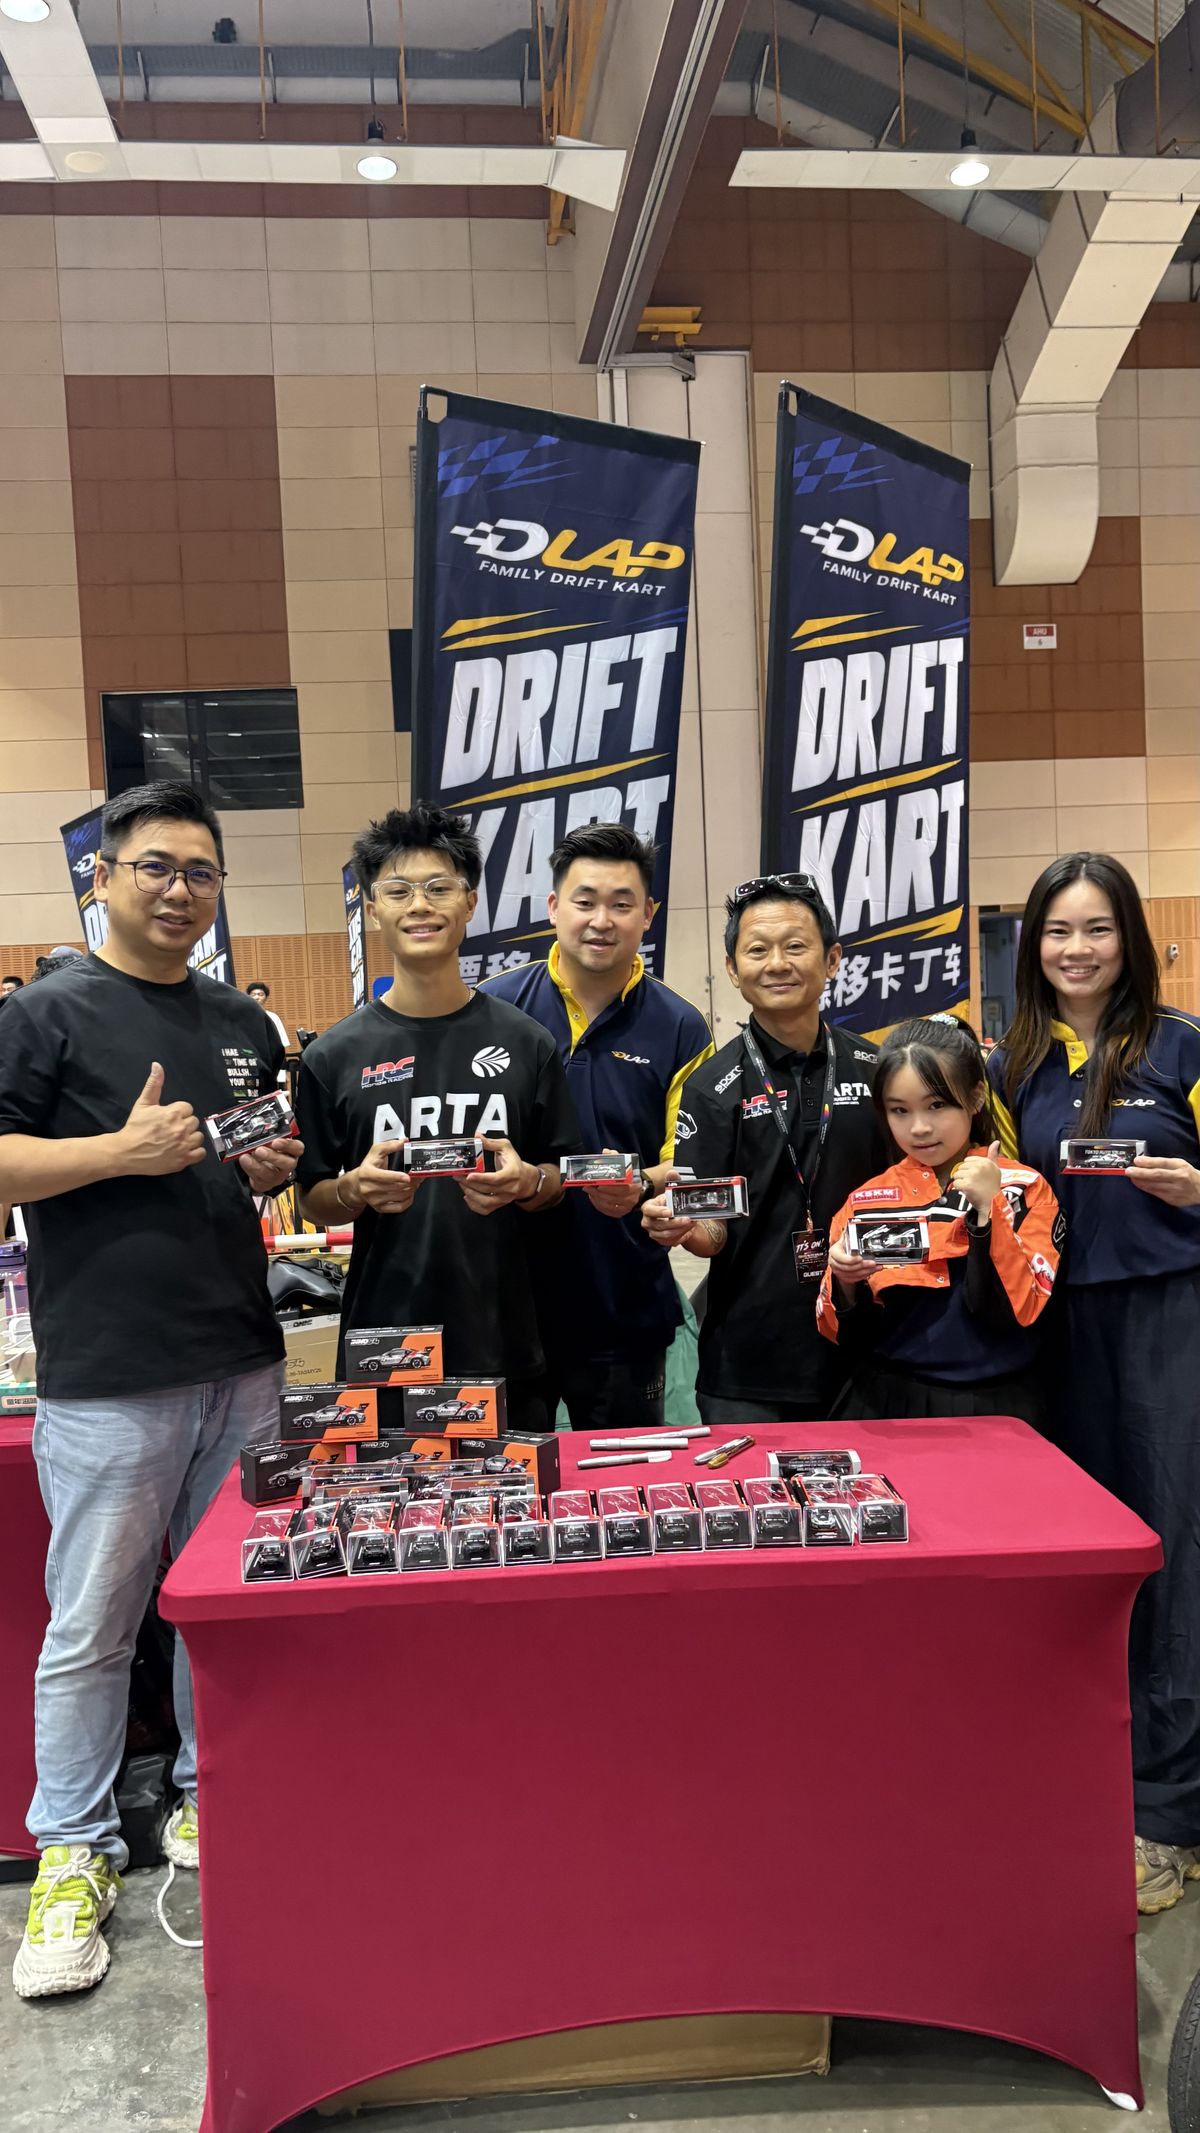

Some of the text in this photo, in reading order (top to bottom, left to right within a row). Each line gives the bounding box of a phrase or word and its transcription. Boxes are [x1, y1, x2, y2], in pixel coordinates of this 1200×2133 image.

[450, 518, 685, 578] DLAP
[800, 518, 964, 585] DLAP
[479, 560, 666, 596] FAMILY DRIFT KART
[822, 560, 957, 606] FAMILY DRIFT KART
[440, 627, 678, 790] DRIFT
[791, 637, 964, 792] DRIFT
[799, 779, 965, 937] KART
[361, 1055, 416, 1086] HRC
[715, 1064, 744, 1094] sparc
[373, 1093, 509, 1145] ARTA
